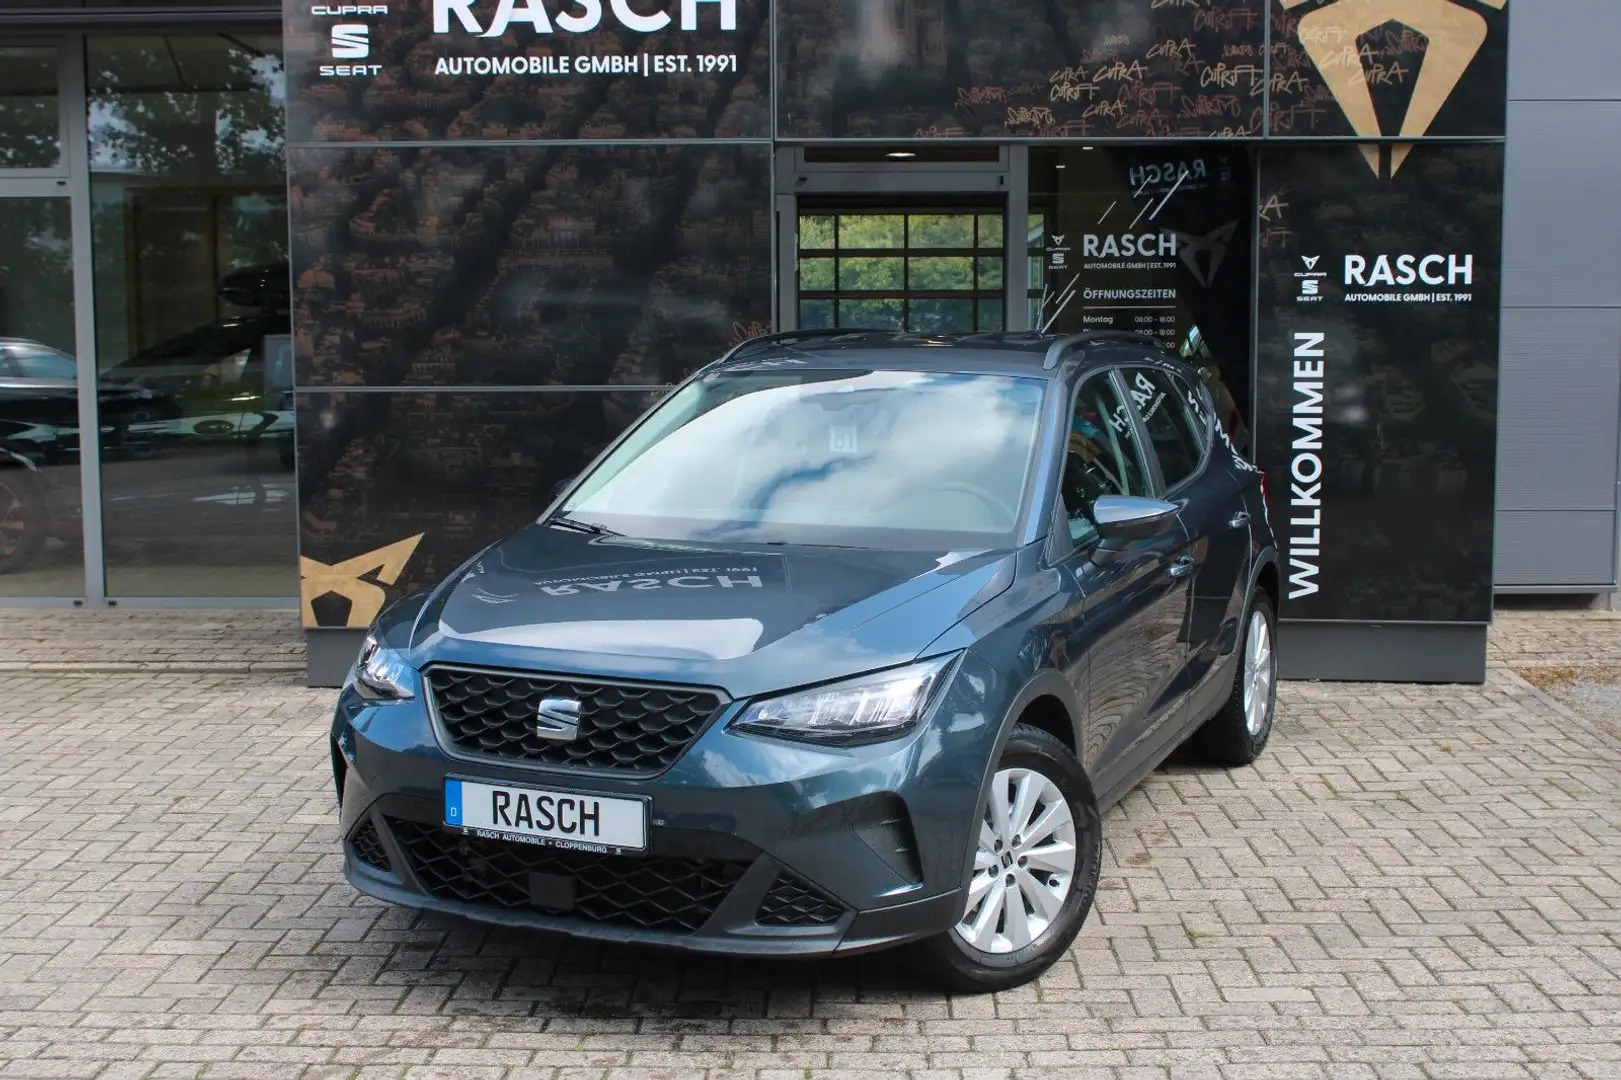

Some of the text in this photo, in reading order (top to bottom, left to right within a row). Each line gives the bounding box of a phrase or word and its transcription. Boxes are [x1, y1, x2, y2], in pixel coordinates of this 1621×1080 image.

[311, 5, 388, 15] CUPRA
[319, 65, 382, 76] SEAT
[434, 56, 570, 75] AUTOMOBILE
[574, 55, 638, 74] GMBH
[655, 54, 692, 73] EST.
[697, 54, 737, 73] 1991
[1083, 233, 1177, 258] RASCH
[1344, 254, 1473, 287] RASCH
[1083, 287, 1176, 299] ÖFFNUNGSZEITEN
[1344, 293, 1402, 302] AUTOMOBILE
[1403, 293, 1431, 302] GMBH
[1454, 293, 1472, 302] 1991
[1083, 316, 1114, 325] Montag
[1288, 332, 1325, 600] WILLKOMMEN
[492, 790, 600, 837] RASCH
[476, 829, 500, 840] RASCH
[502, 833, 546, 846] AUTOMOBILE
[555, 841, 608, 853] CLOPPENBURG
